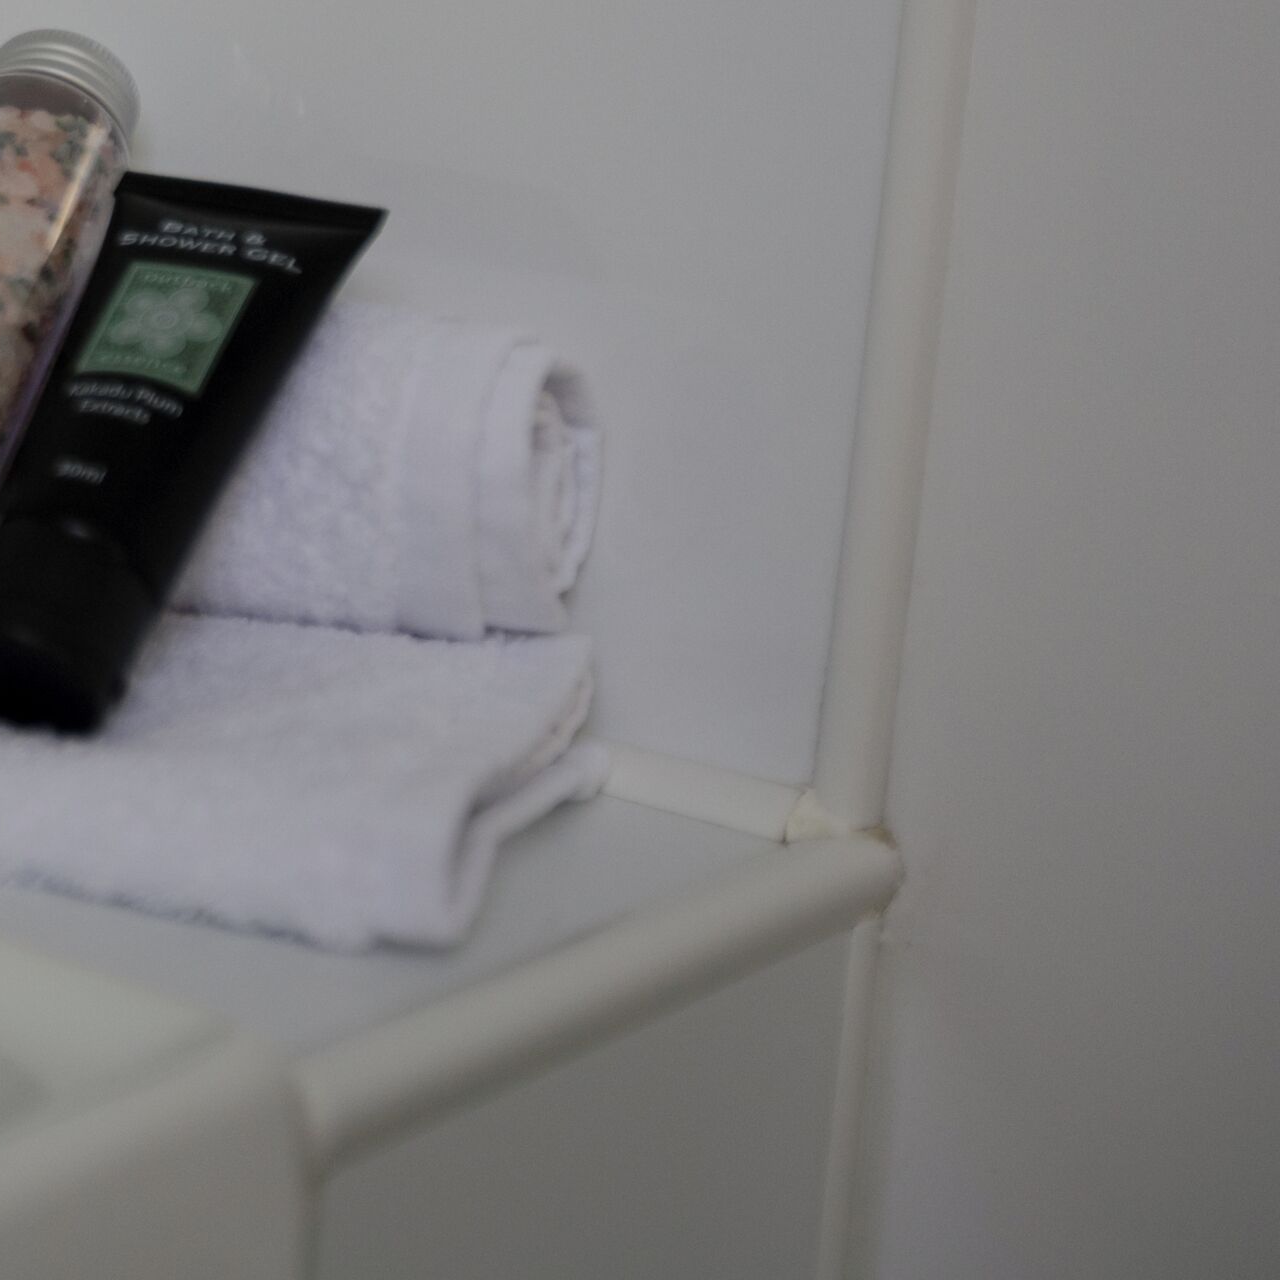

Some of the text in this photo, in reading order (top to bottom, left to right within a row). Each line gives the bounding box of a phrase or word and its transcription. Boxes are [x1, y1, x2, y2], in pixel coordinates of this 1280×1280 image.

[160, 219, 237, 243] BATH
[116, 230, 304, 275] SHOWER GEL
